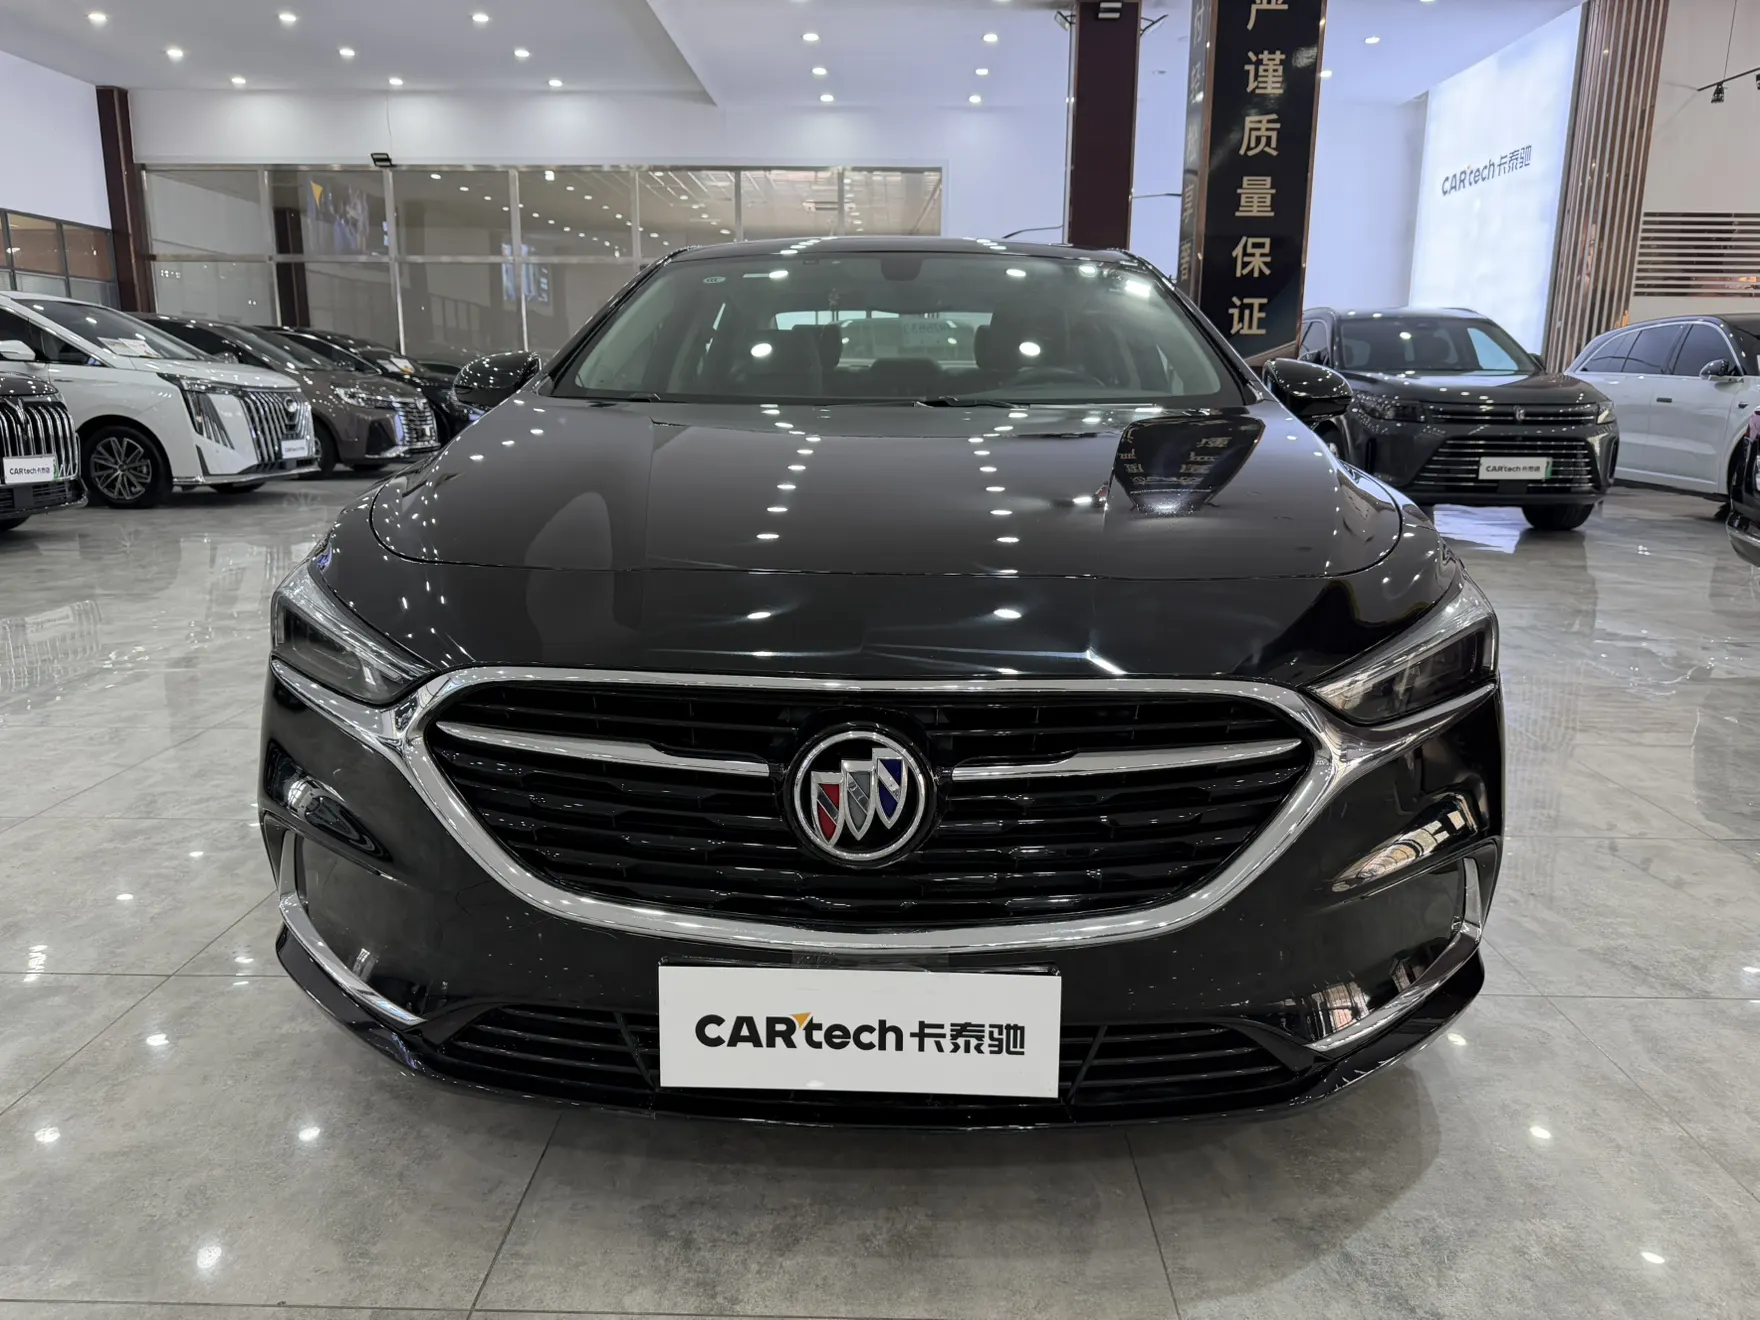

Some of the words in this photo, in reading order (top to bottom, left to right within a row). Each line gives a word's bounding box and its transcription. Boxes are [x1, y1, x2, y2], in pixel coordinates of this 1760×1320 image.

[1228, 0, 1289, 336] 严谨质量保证
[695, 1013, 904, 1051] CARtech
[909, 1020, 1025, 1056] 卡泰驰
